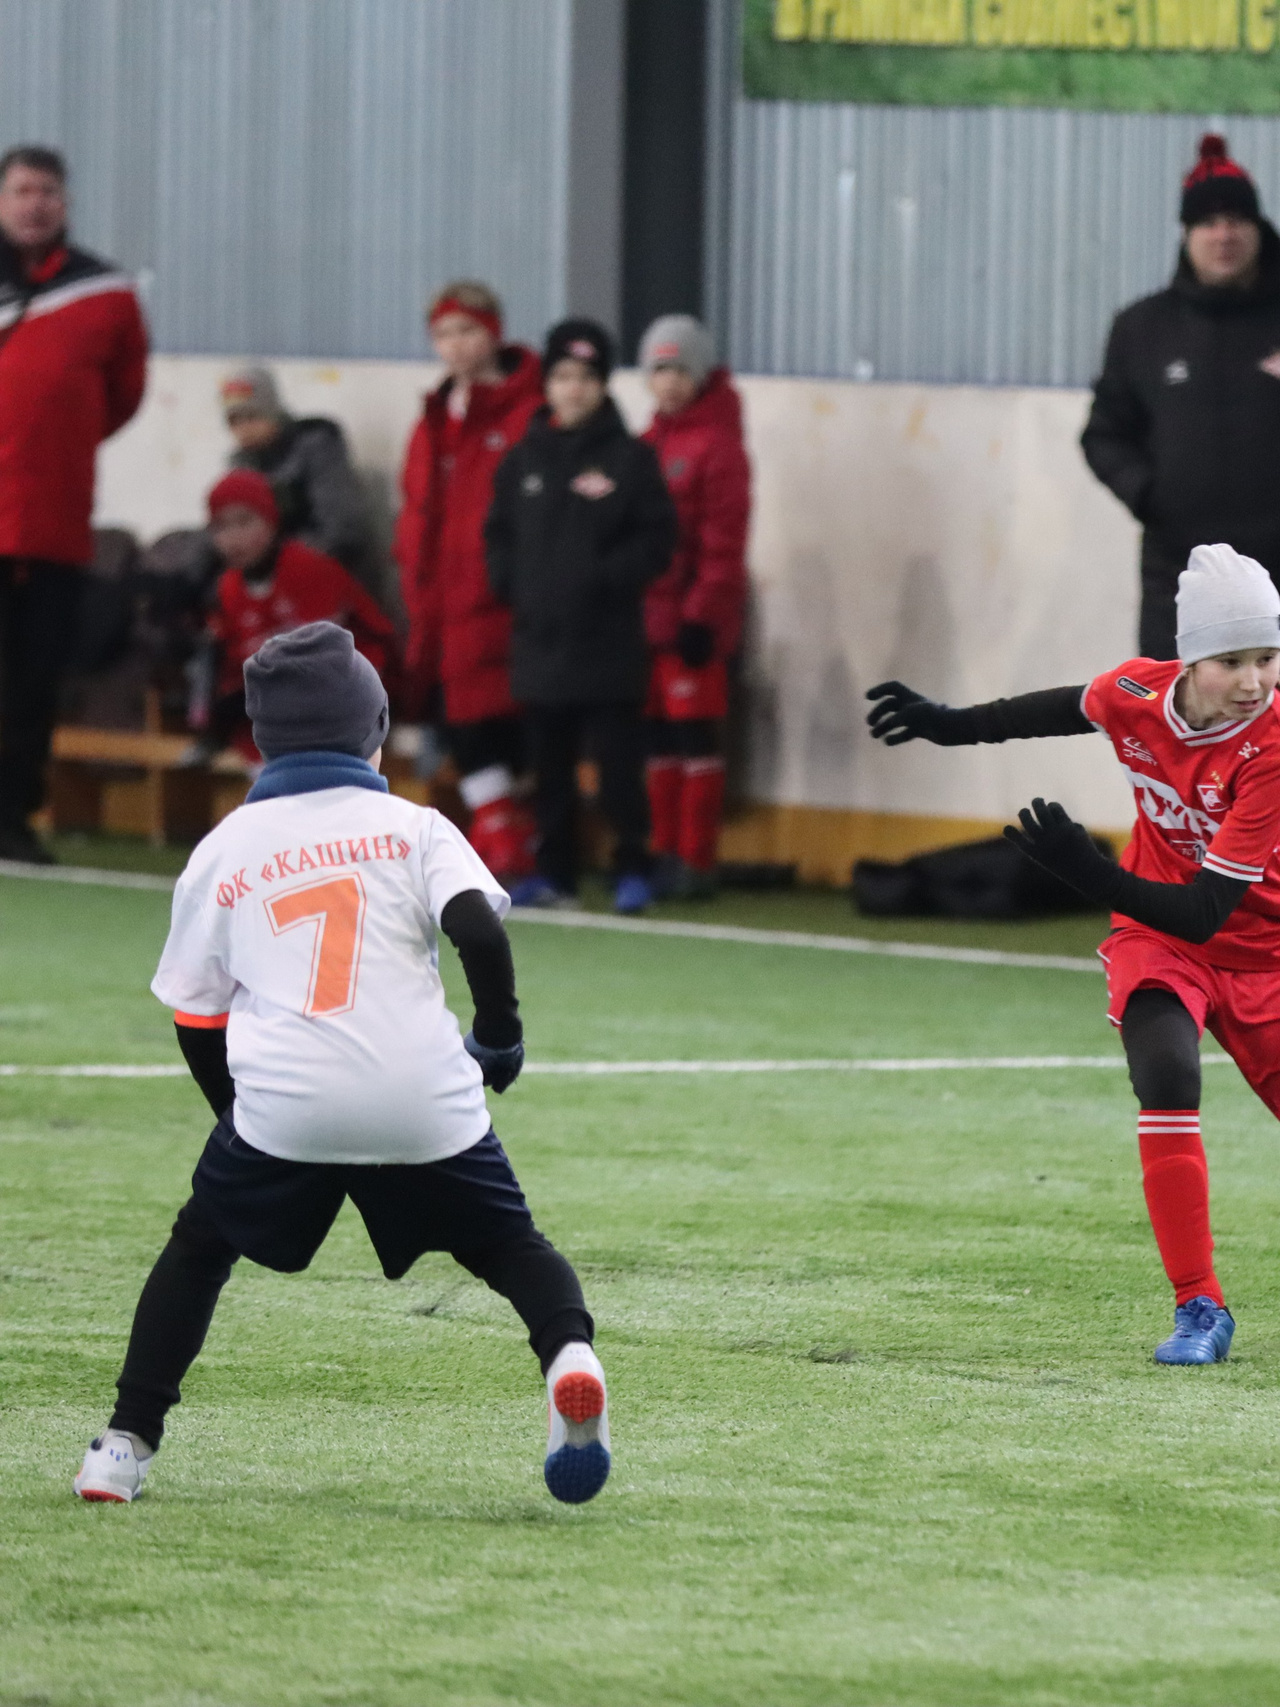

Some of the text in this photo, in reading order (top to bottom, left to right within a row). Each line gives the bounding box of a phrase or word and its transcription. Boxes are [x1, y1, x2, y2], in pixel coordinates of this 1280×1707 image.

[215, 834, 412, 910] ФК «КАШИН»
[262, 871, 368, 1019] 7
